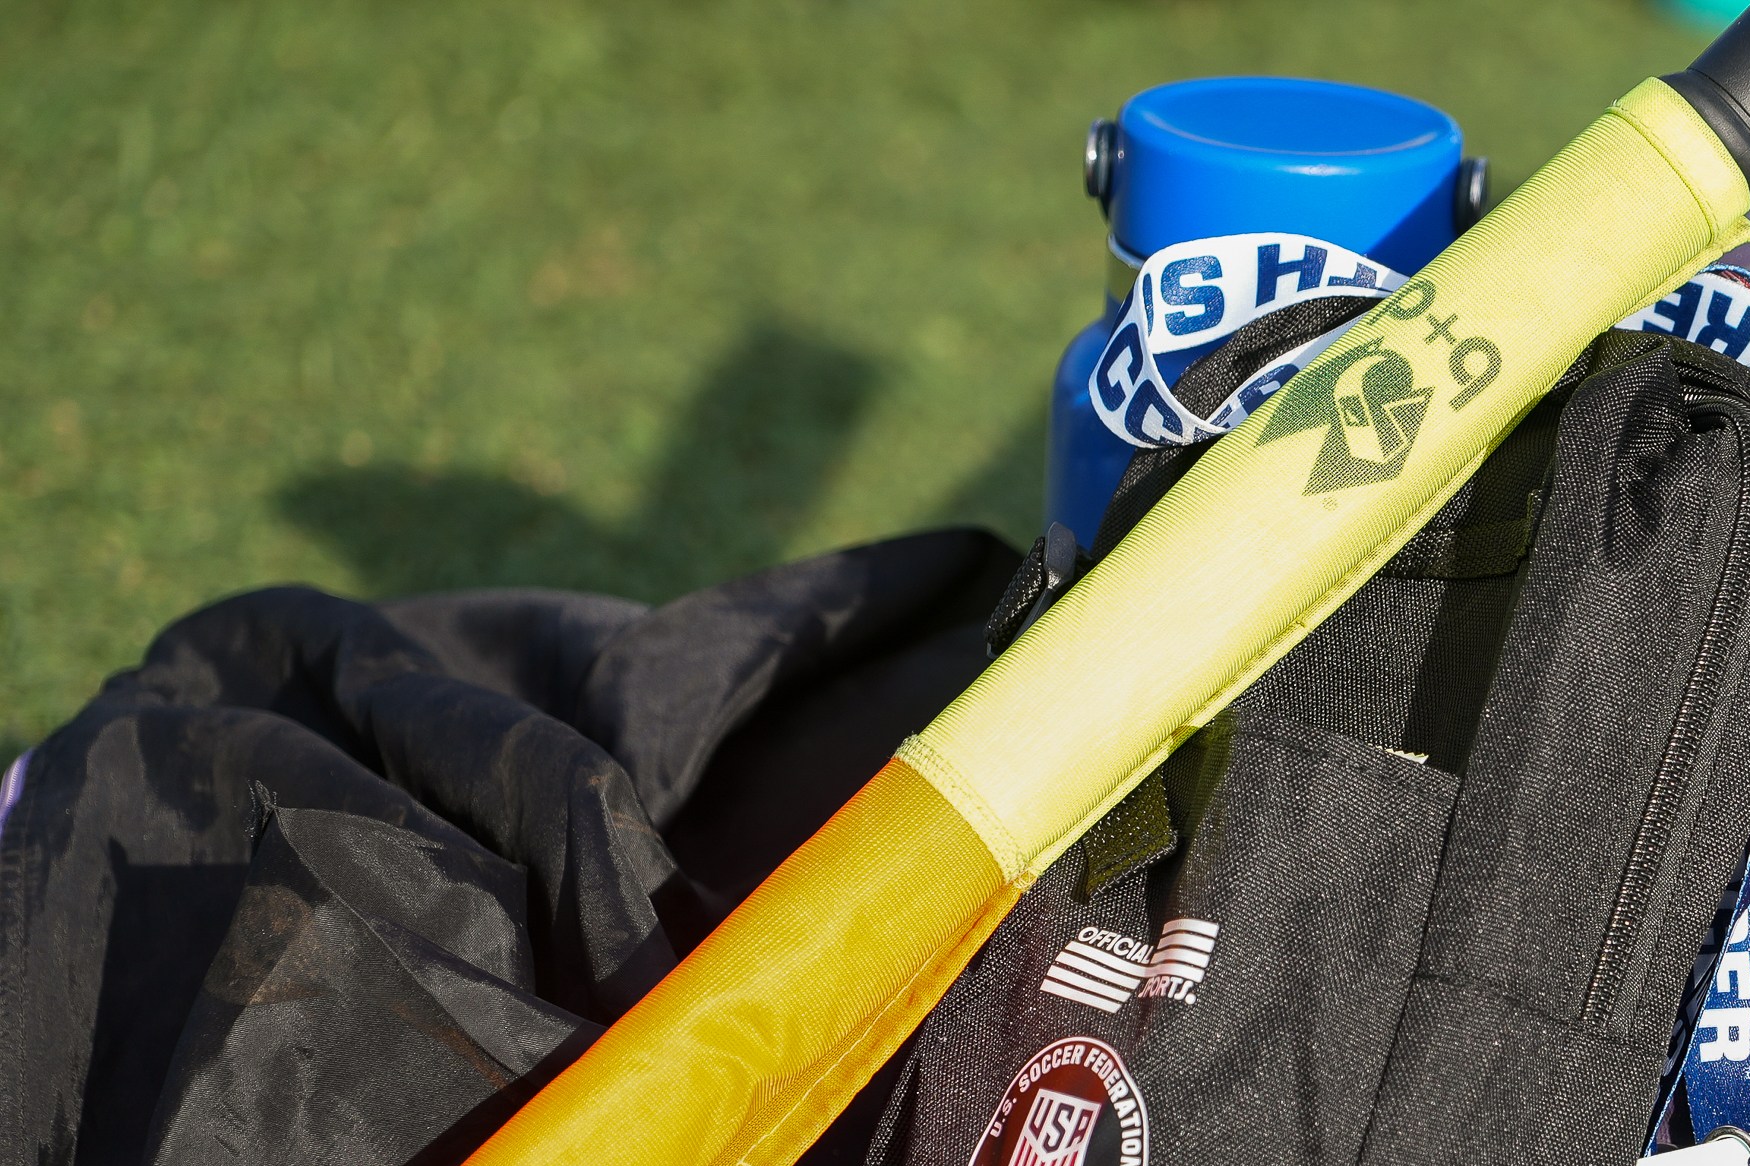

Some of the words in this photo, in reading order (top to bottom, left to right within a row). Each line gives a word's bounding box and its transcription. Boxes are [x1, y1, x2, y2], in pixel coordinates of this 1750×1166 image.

[1077, 926, 1154, 965] OFFICIAL
[1018, 1044, 1086, 1093] SOCCER
[1028, 1096, 1094, 1153] USA
